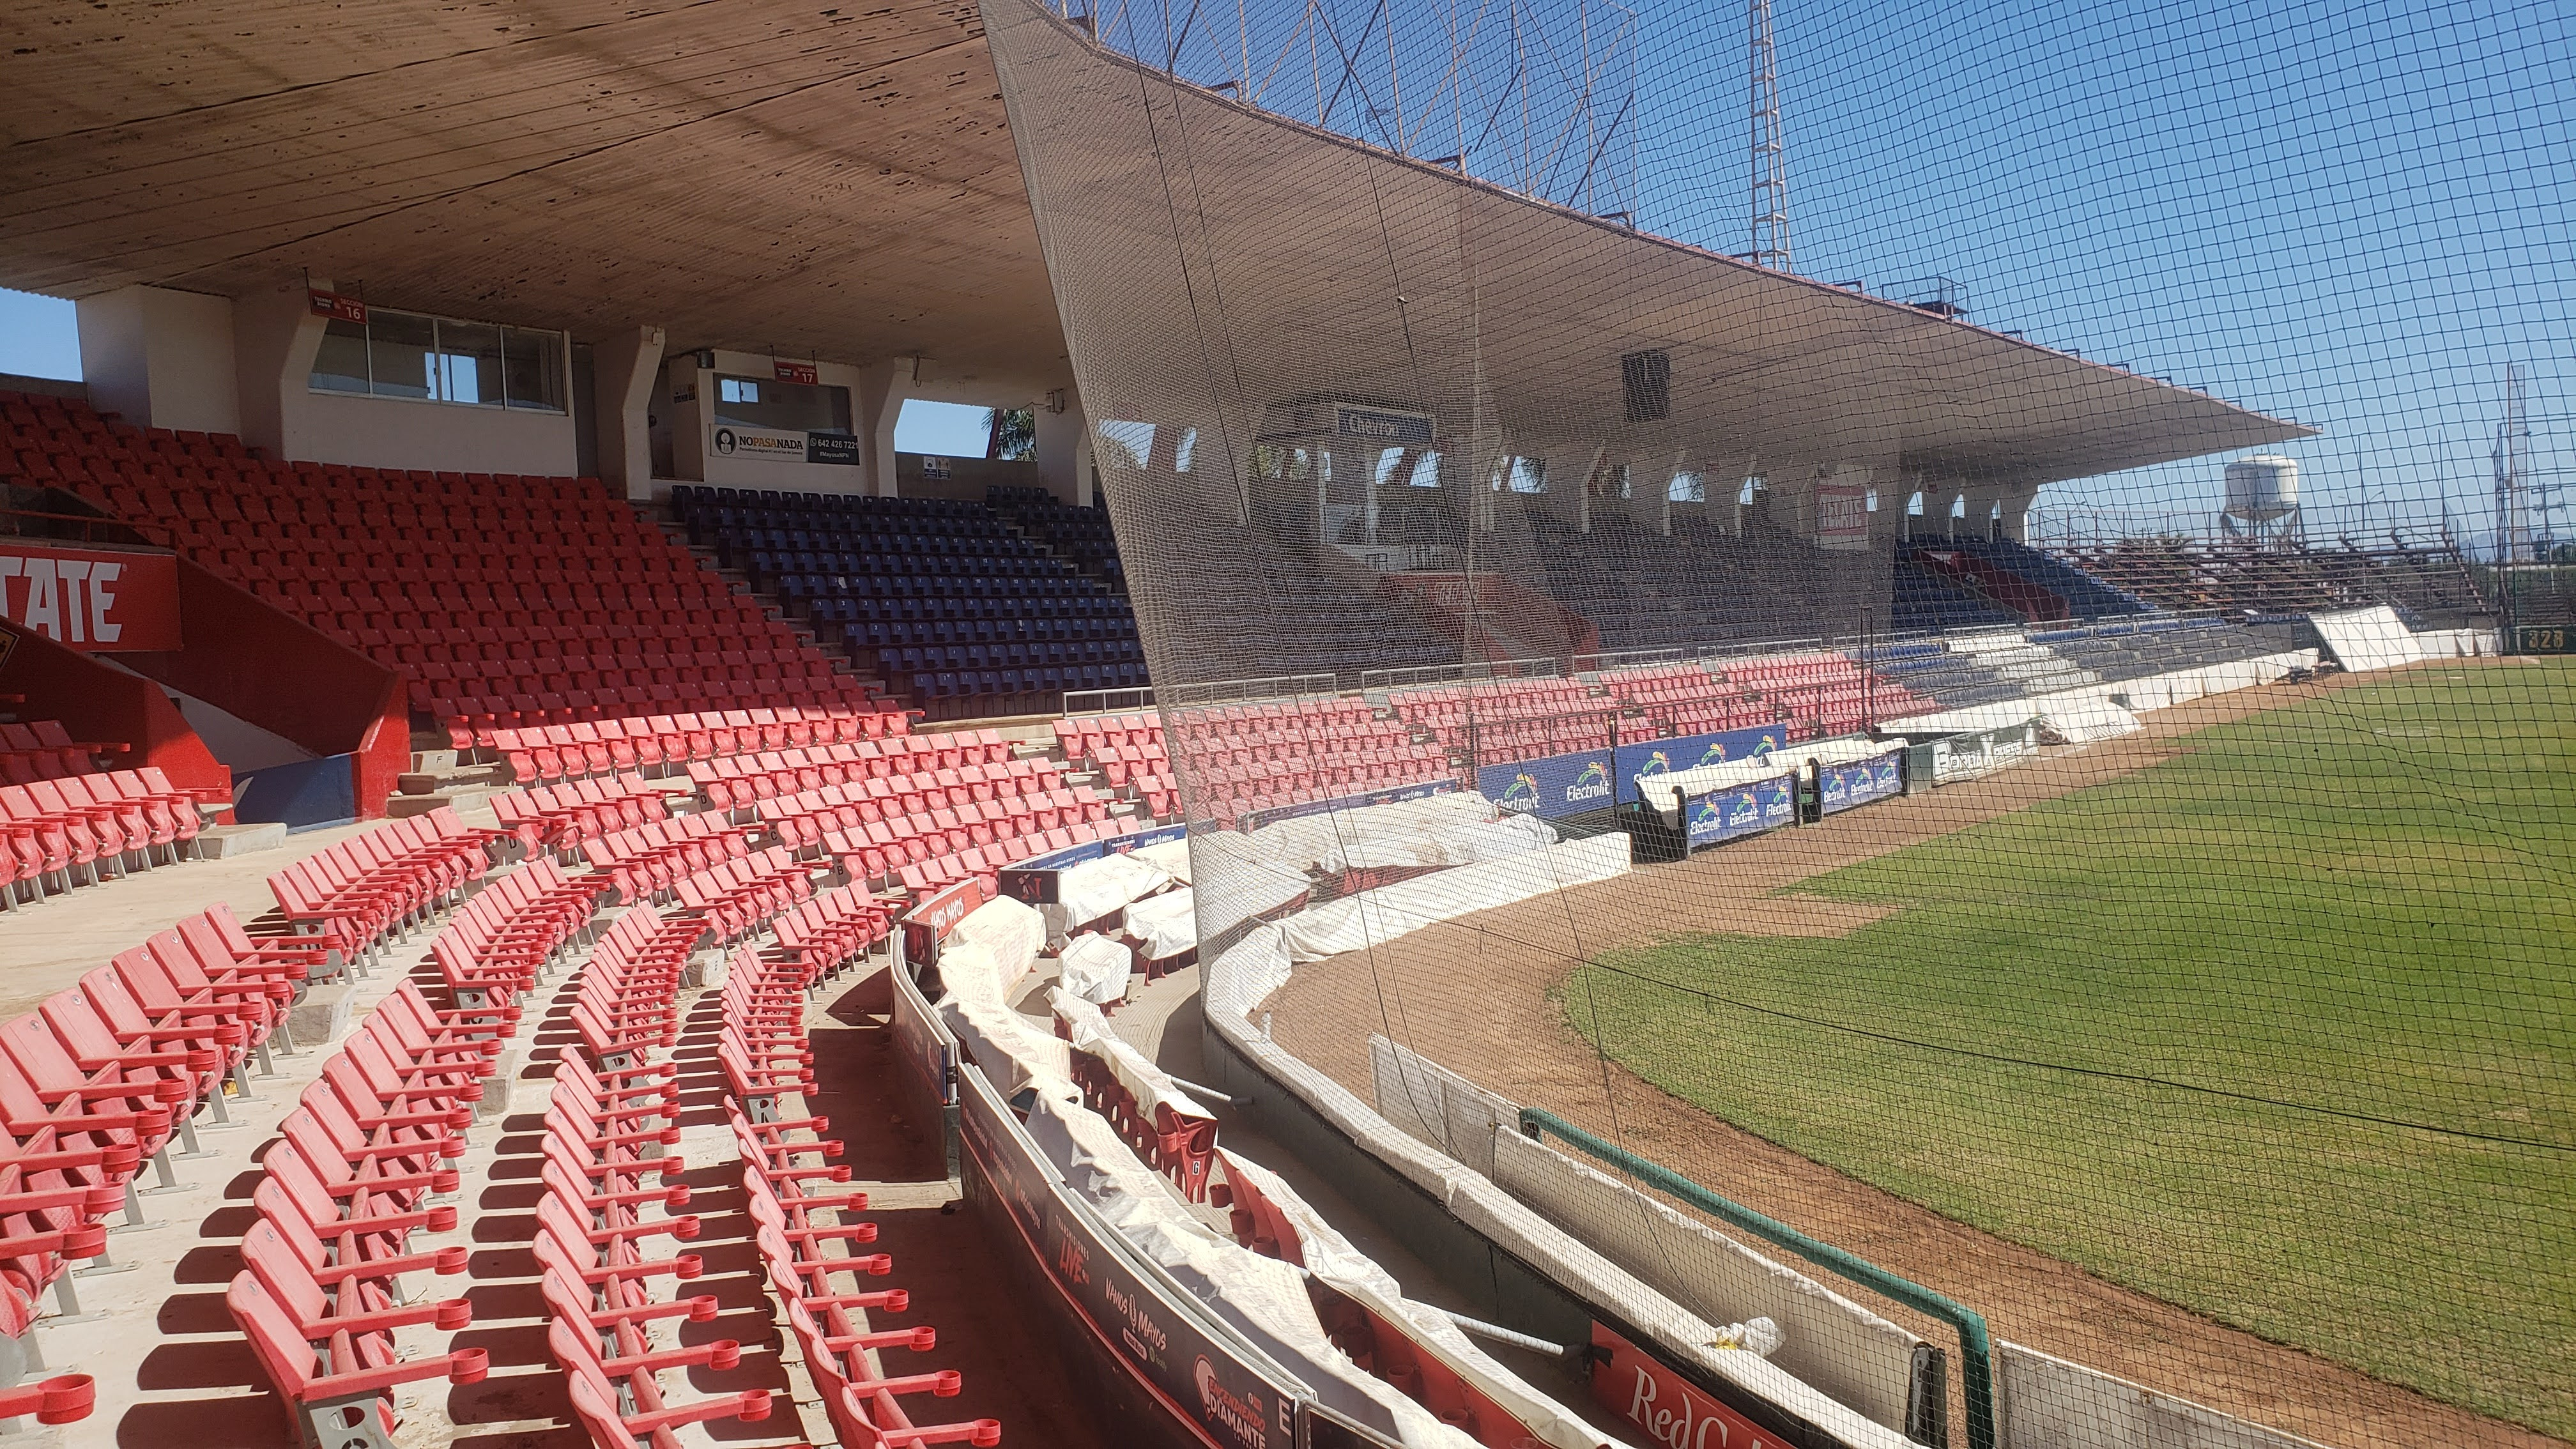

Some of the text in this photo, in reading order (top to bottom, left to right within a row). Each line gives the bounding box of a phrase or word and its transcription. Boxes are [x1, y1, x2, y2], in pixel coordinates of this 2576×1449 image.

[346, 307, 360, 319] 16
[802, 373, 813, 383] 17
[739, 436, 804, 450] NOPASANADA
[818, 439, 830, 448] 642
[831, 440, 843, 448] 426
[2528, 630, 2564, 648] 328
[436, 755, 443, 764] F
[700, 794, 707, 804] D
[1567, 780, 1610, 802] Electrolit
[1690, 816, 1722, 835] Electrolit
[1729, 808, 1760, 826] Electrolit
[770, 831, 778, 841] C
[946, 896, 964, 924] MAYOS
[1193, 1162, 1199, 1174] G
[1055, 1215, 1090, 1261] TRANSMISIONES
[1059, 1238, 1084, 1283] LIVE
[1105, 1276, 1128, 1315] VAMOS
[1138, 1310, 1167, 1351] MAYOS
[1208, 1377, 1266, 1432] ENCENDIENDO
[1209, 1393, 1266, 1449] DIAMANTE
[1278, 1397, 1292, 1438] E
